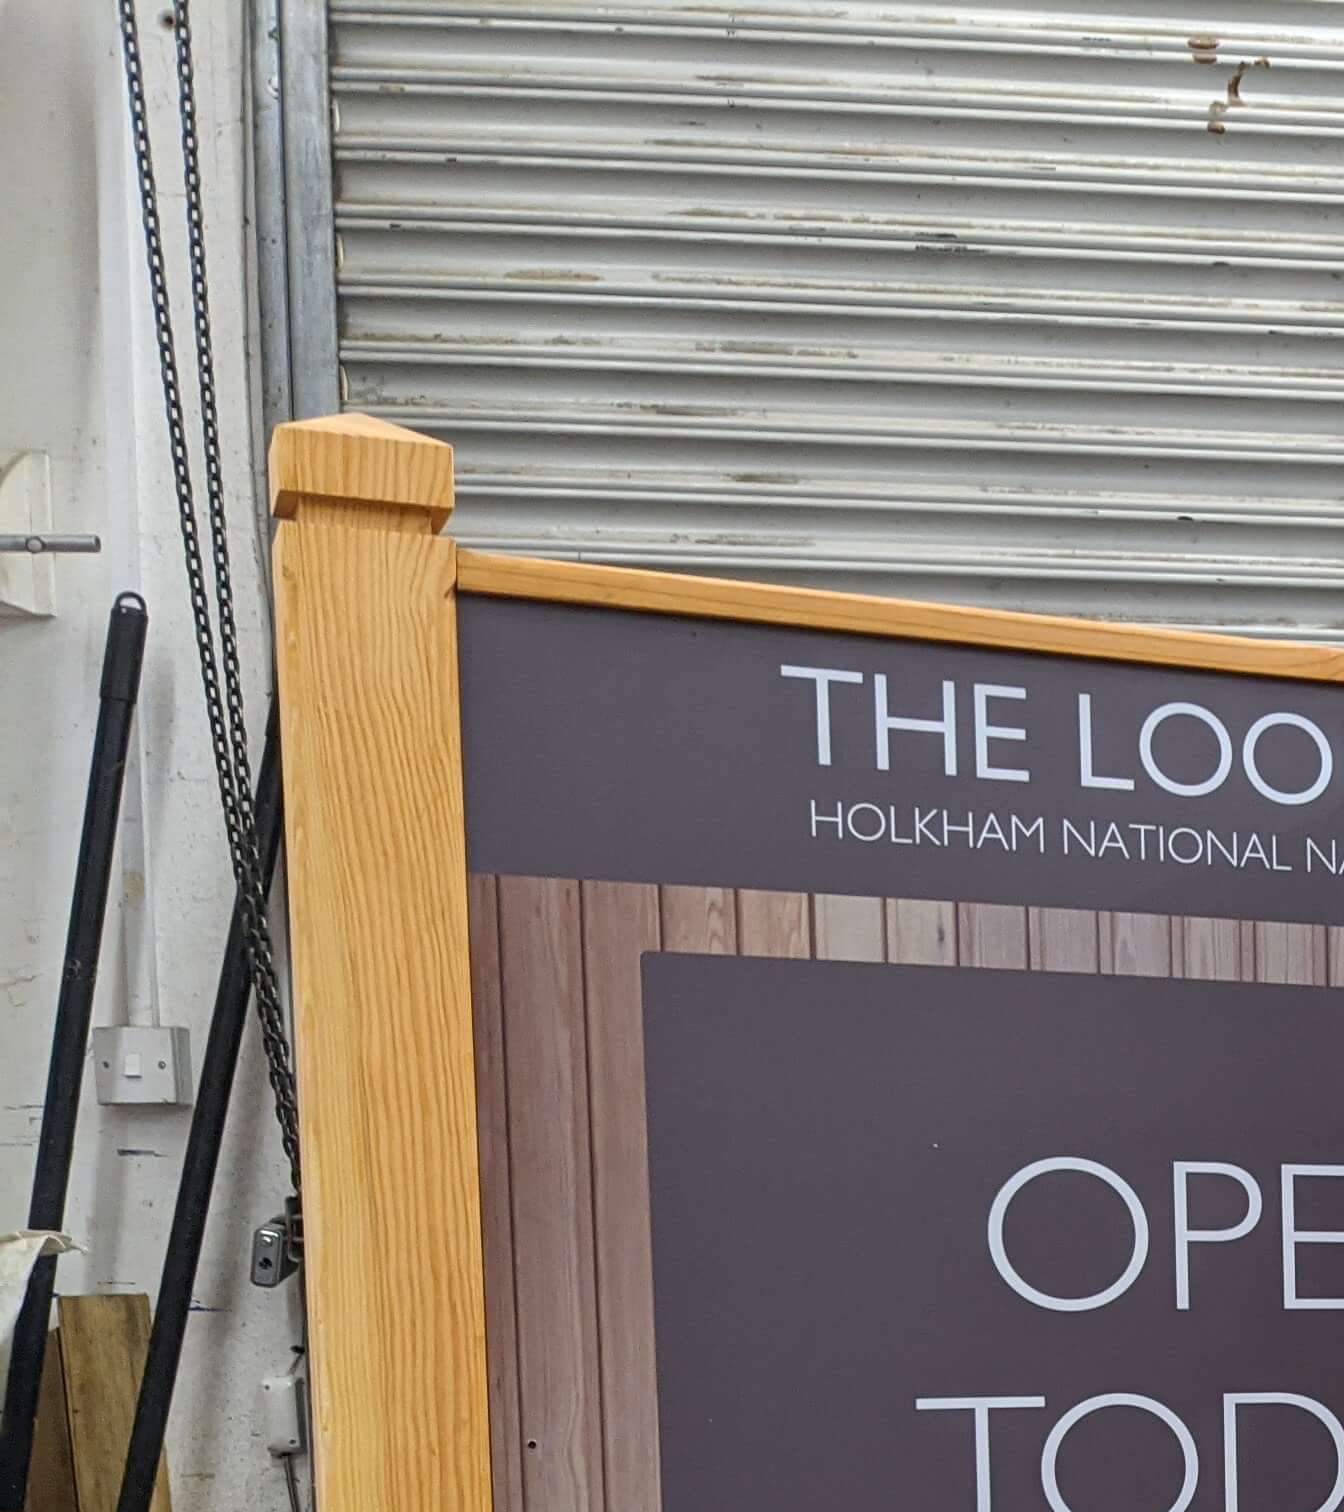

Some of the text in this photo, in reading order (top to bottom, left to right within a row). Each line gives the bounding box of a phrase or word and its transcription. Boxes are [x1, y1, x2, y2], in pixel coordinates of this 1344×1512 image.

[780, 664, 1030, 783] THE
[810, 799, 1045, 854] HOLKHAM
[1062, 818, 1293, 871] NATIONAL
